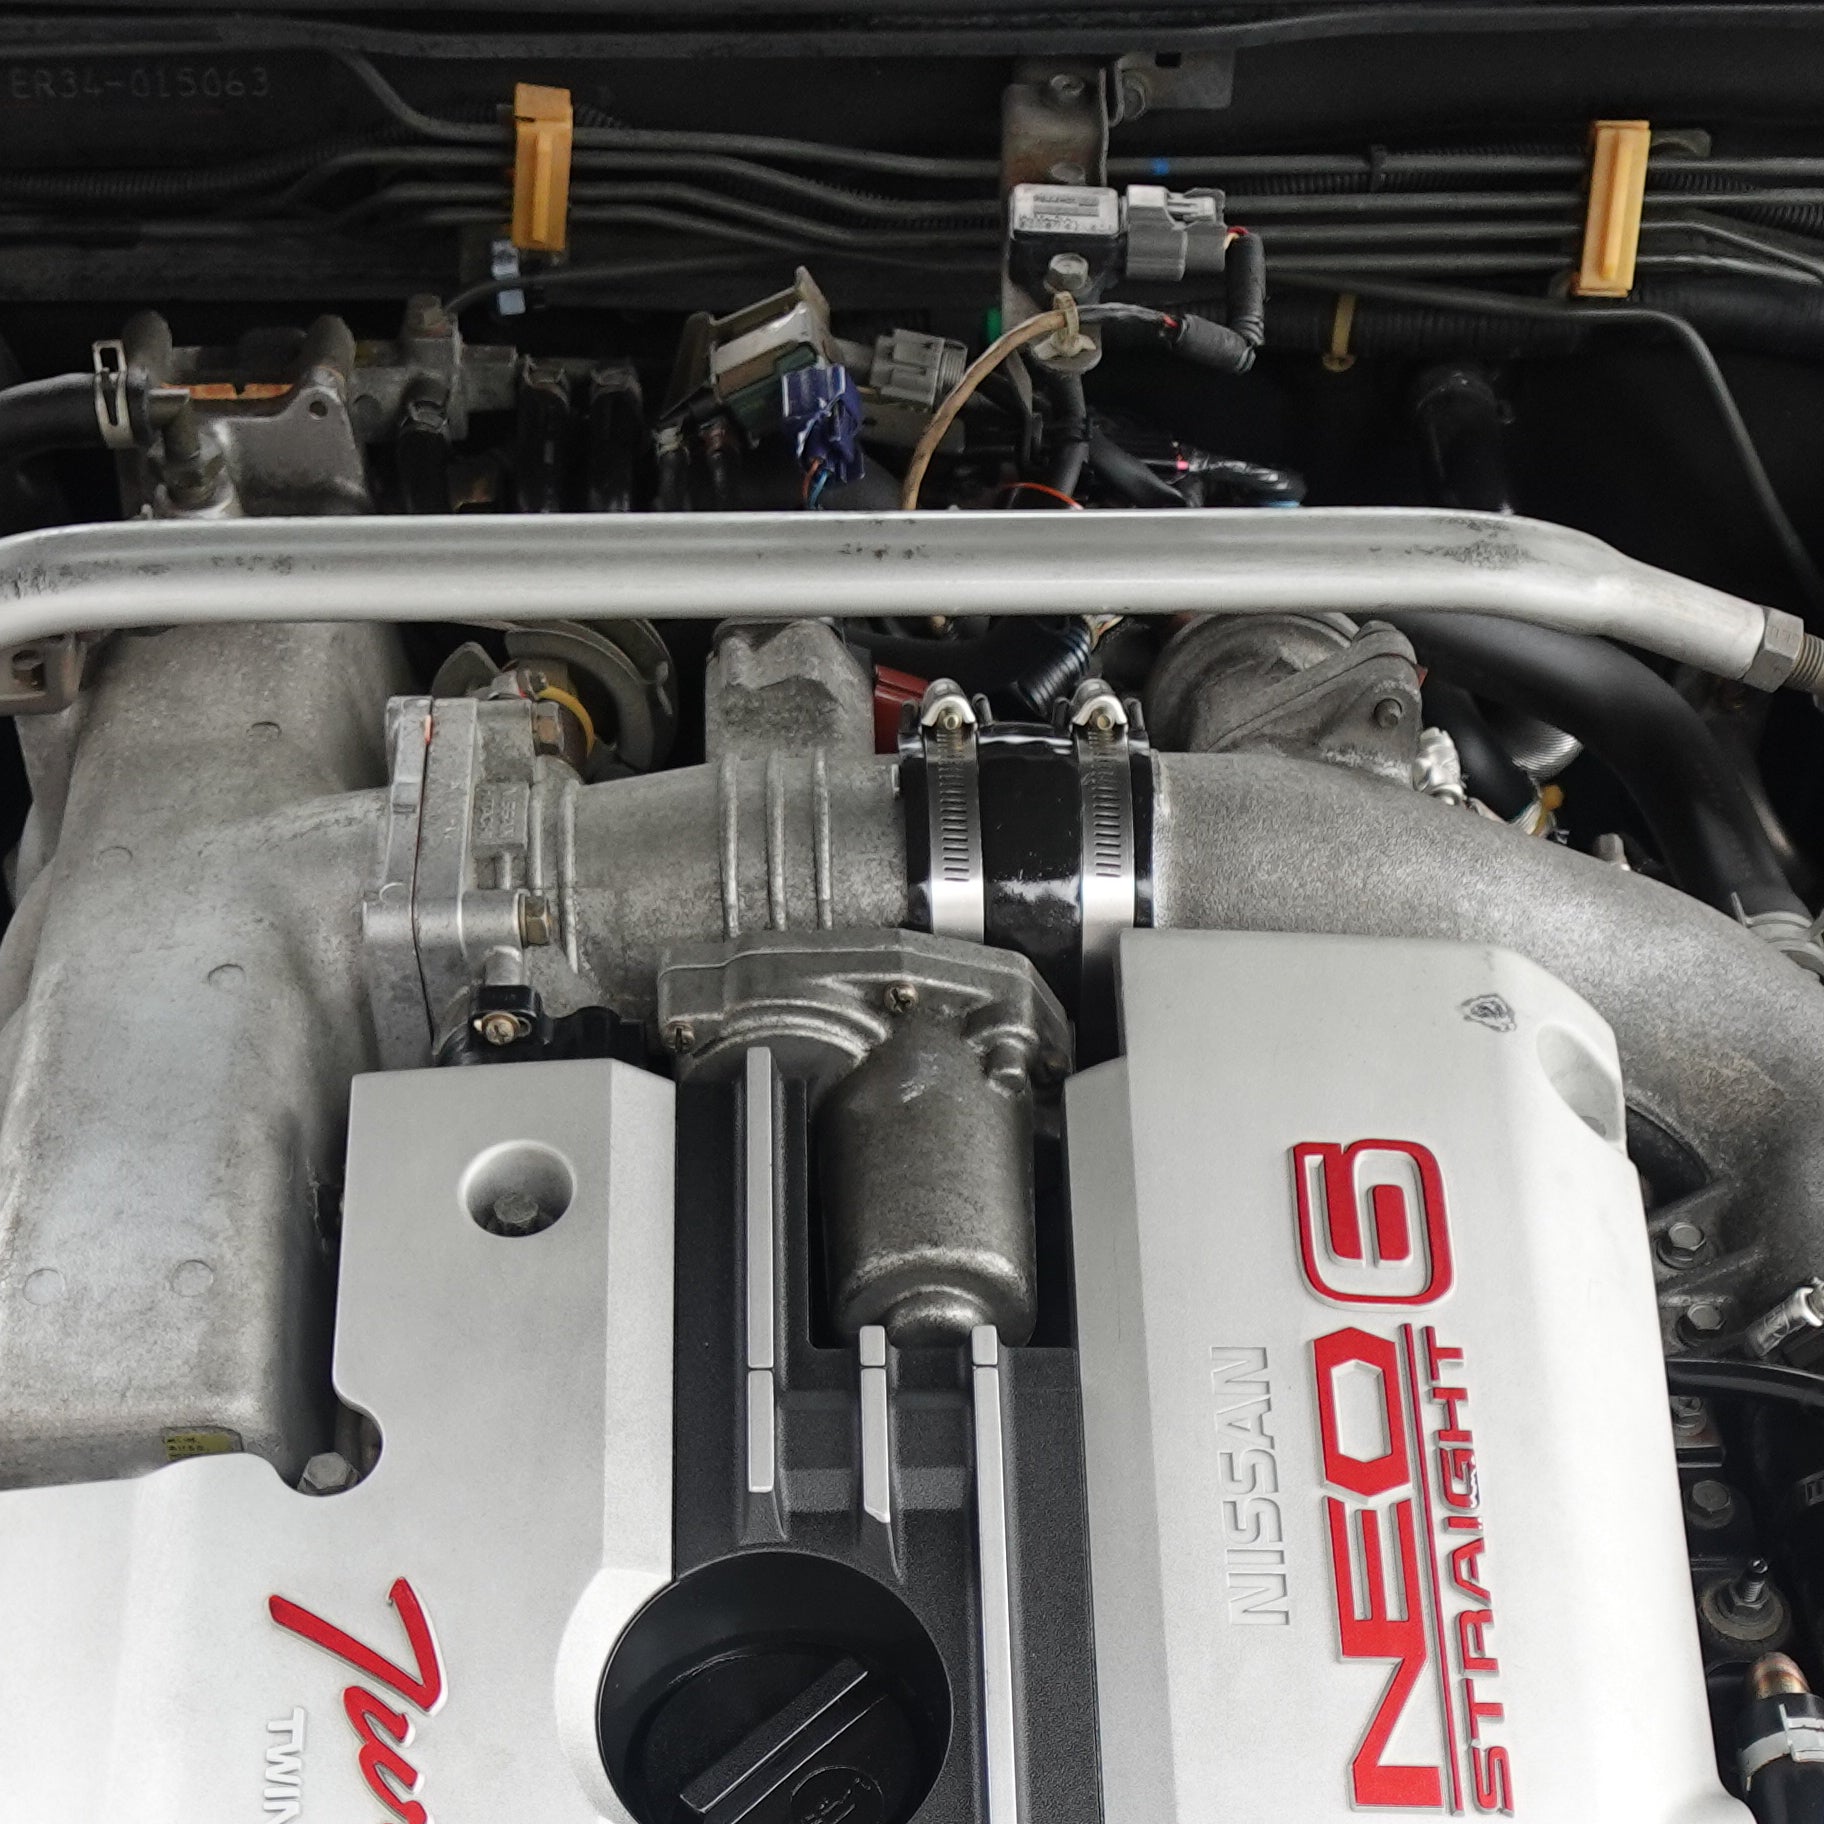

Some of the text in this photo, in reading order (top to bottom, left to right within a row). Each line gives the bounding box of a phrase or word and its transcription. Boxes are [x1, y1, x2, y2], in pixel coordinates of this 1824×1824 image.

[6, 66, 269, 98] ER34-015063
[1209, 1345, 1291, 1627] NISSAN
[1422, 1325, 1515, 1817] STRAIGHT
